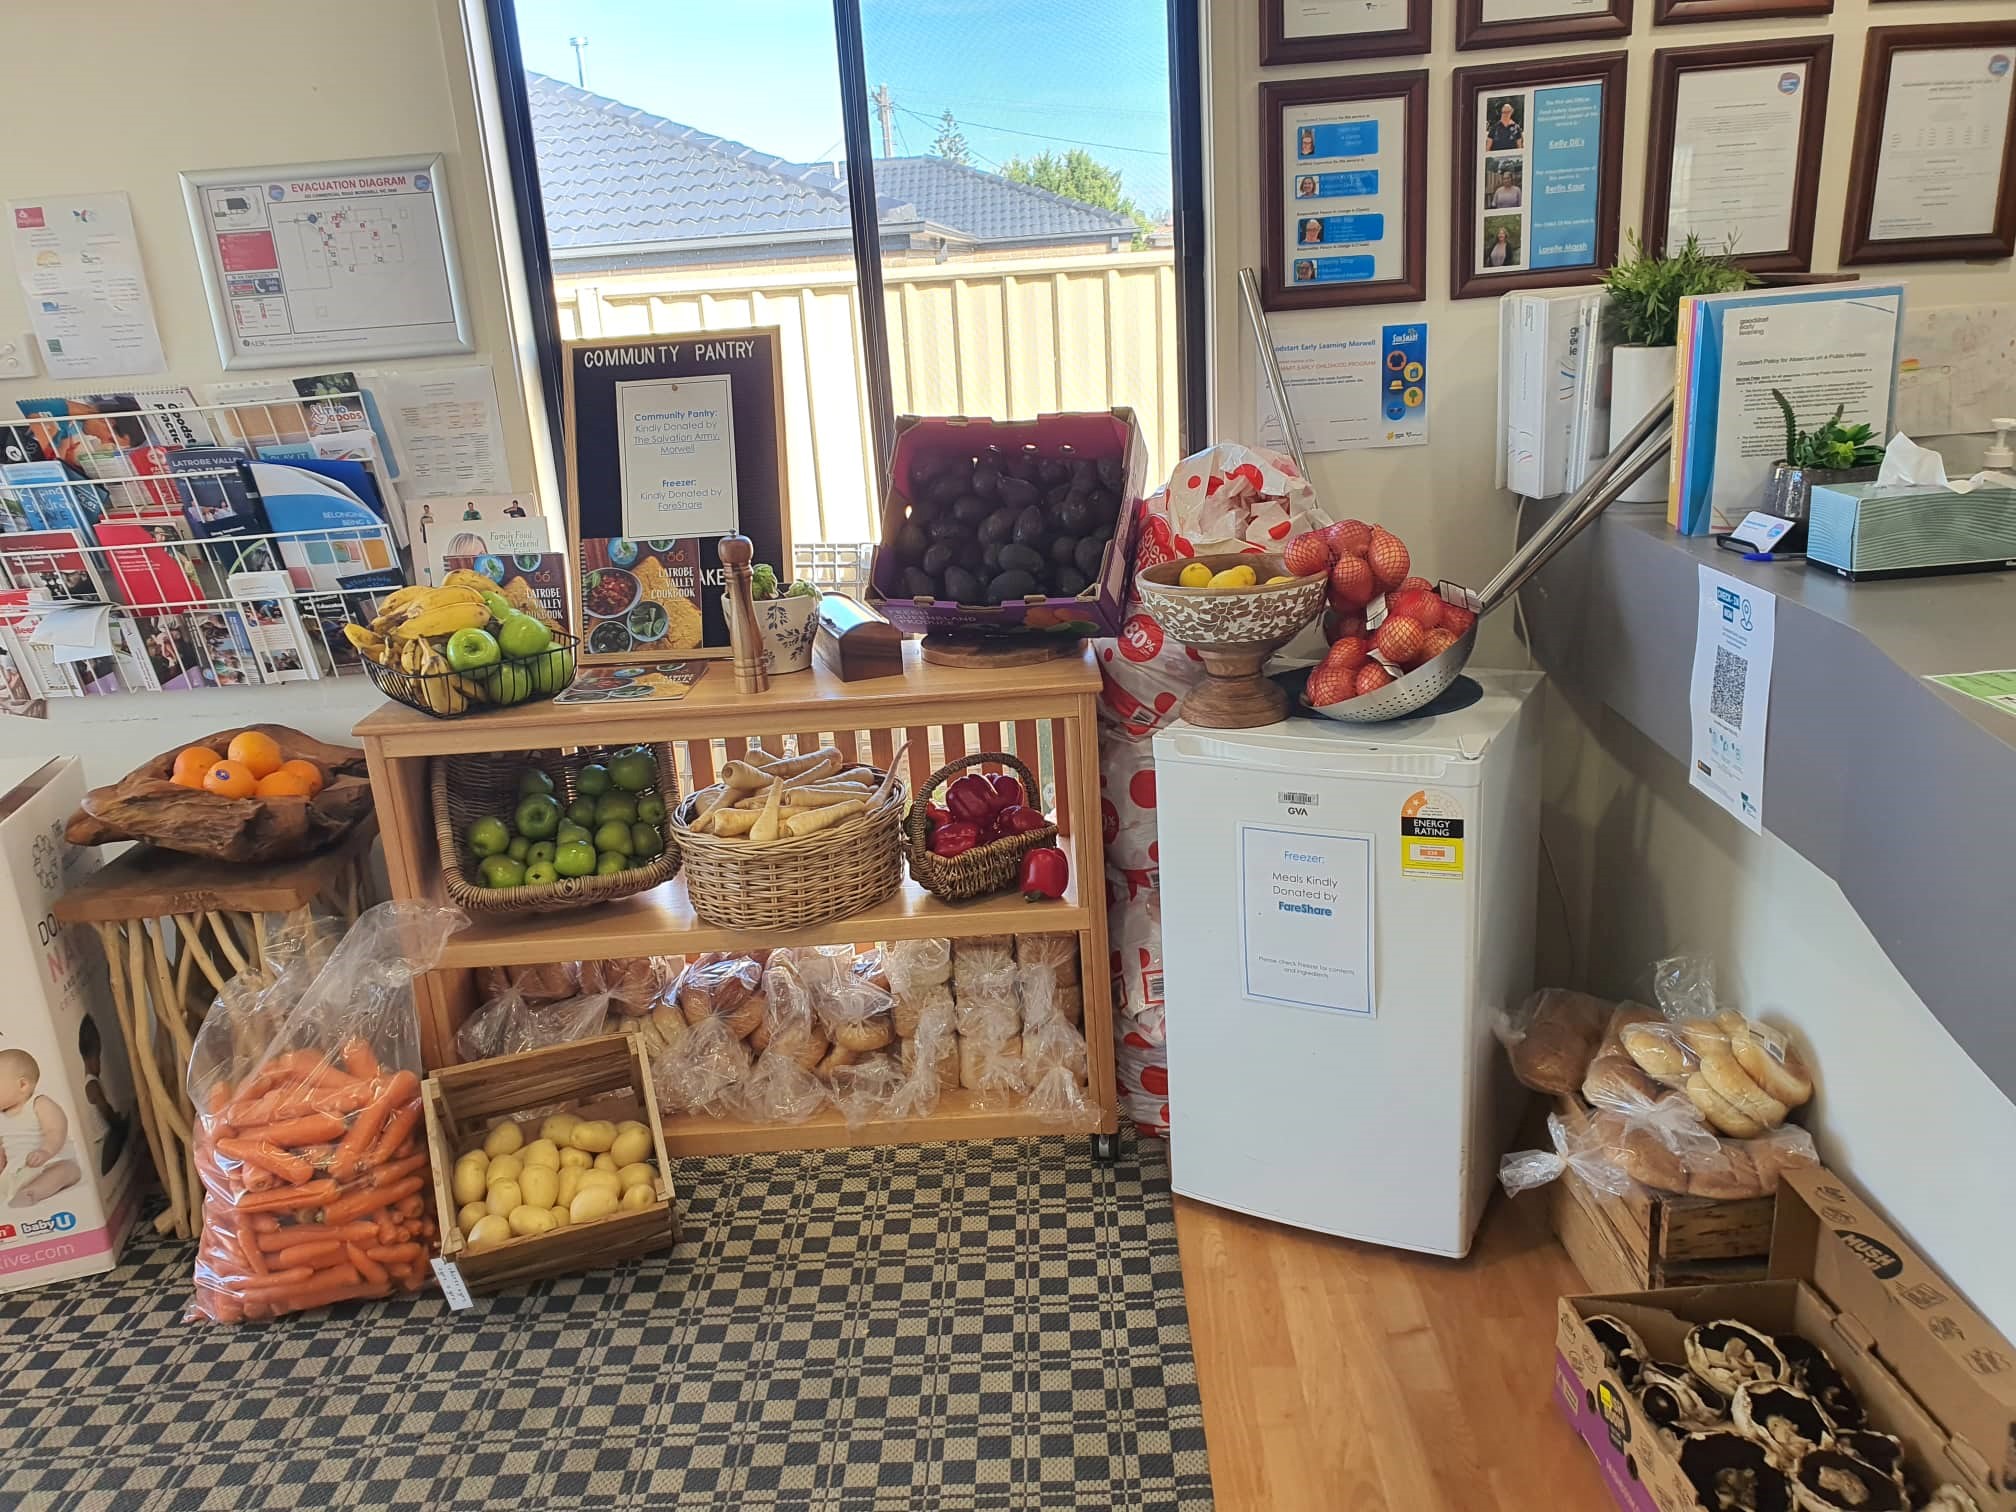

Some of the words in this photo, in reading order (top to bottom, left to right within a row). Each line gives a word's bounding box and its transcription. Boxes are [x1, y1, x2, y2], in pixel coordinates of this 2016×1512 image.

[291, 180, 356, 193] EVACUATION
[359, 176, 406, 188] DIAGRAM
[695, 340, 755, 362] PANTRY
[1319, 341, 1347, 351] Learning
[634, 411, 685, 422] Community
[687, 409, 718, 420] Pantry:
[635, 422, 662, 433] Kindly
[663, 421, 704, 431] Donated
[706, 419, 718, 430] by
[634, 435, 650, 445] The
[652, 433, 693, 444] Salvation
[660, 444, 695, 455] Morwell
[172, 458, 212, 467] LATROBE
[662, 479, 697, 488] Freezer:
[640, 491, 666, 501] Kindly
[668, 489, 708, 500] Donated
[710, 487, 722, 497] by
[658, 501, 703, 512] FareShare
[490, 530, 513, 542] Family
[508, 539, 539, 549] Weekend
[659, 566, 694, 578] LATROBE
[665, 577, 695, 587] VALLEY
[526, 587, 561, 598] LATROBE
[651, 587, 695, 599] COOKBOOK
[534, 598, 562, 609] VALLEY
[1123, 621, 1157, 653] 80%
[1287, 806, 1308, 816] GVA
[1413, 818, 1450, 829] ENERGY
[1414, 827, 1450, 837] RATING
[1284, 850, 1325, 864] Freezer:
[1272, 872, 1304, 884] Meals
[1306, 875, 1338, 888] Kindly
[1272, 885, 1321, 900] Donated
[1323, 890, 1338, 903] by
[1278, 901, 1333, 917] FareShare
